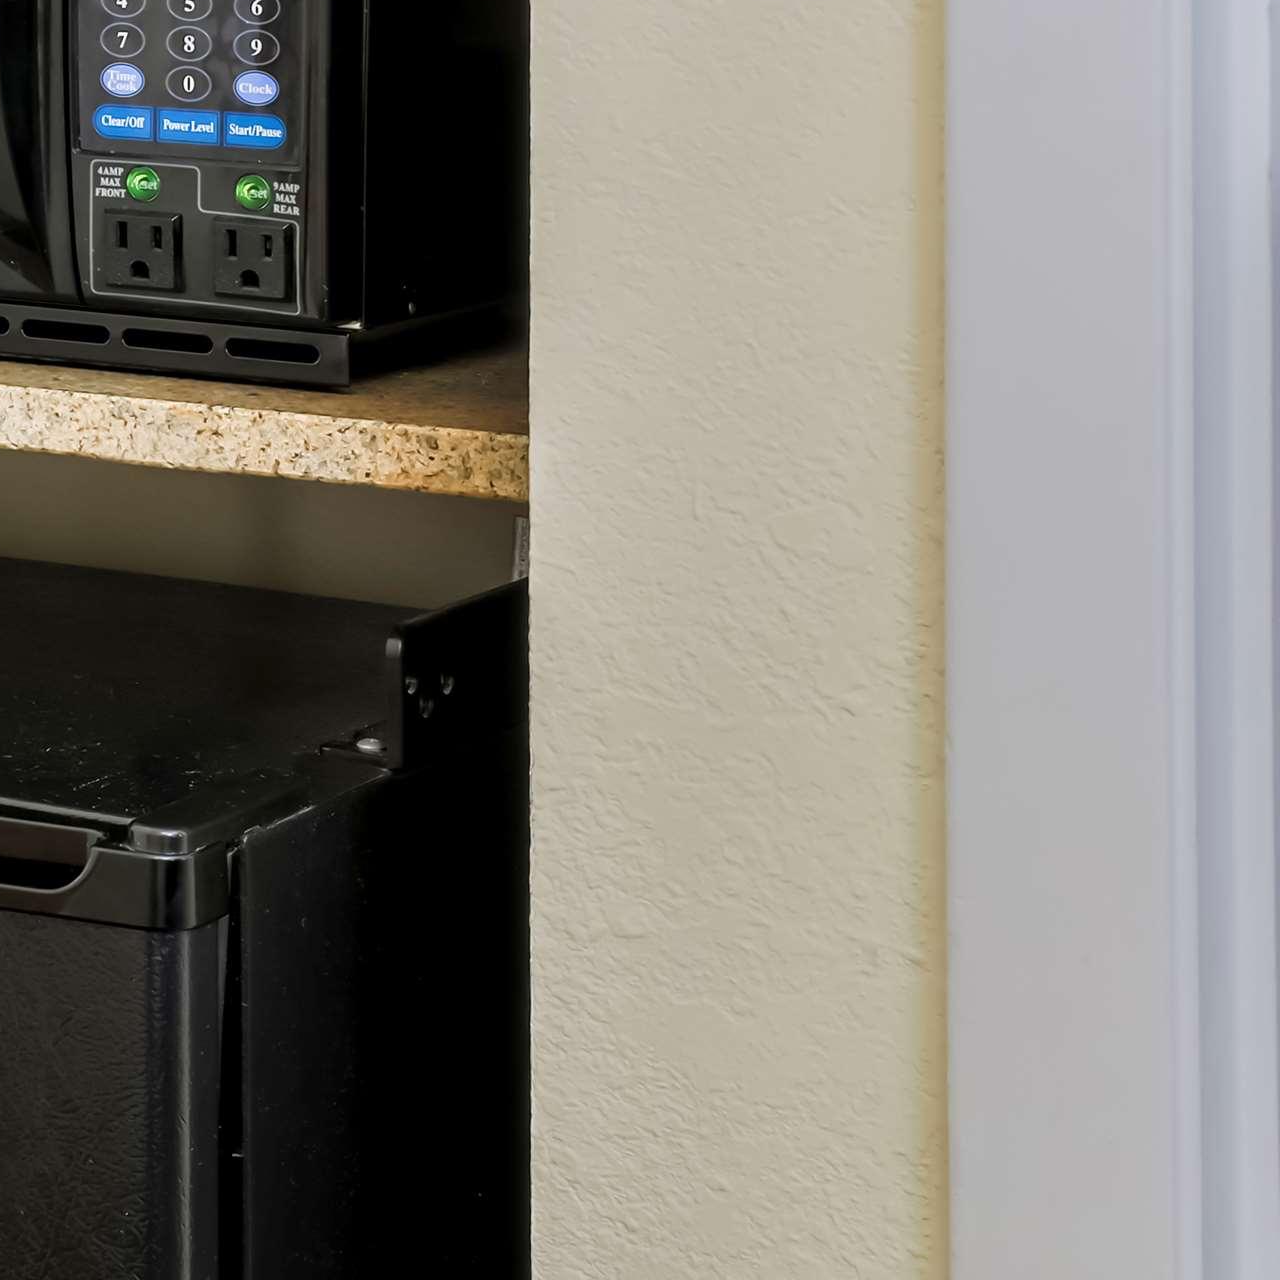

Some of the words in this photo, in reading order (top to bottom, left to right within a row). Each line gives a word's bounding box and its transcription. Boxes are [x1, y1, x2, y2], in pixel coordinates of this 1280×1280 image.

[117, 31, 129, 49] 7
[183, 35, 195, 53] 8
[250, 39, 262, 56] 9
[107, 70, 137, 81] Time
[183, 75, 195, 93] 0
[238, 81, 273, 95] Clock
[101, 115, 145, 128] Clear/Off
[163, 119, 190, 131] Power
[191, 120, 214, 133] Level
[229, 123, 282, 137] Start/Pause
[100, 177, 121, 187] MAX
[95, 187, 127, 198] FRONT
[275, 193, 297, 204] MAX
[273, 204, 300, 216] REAR
